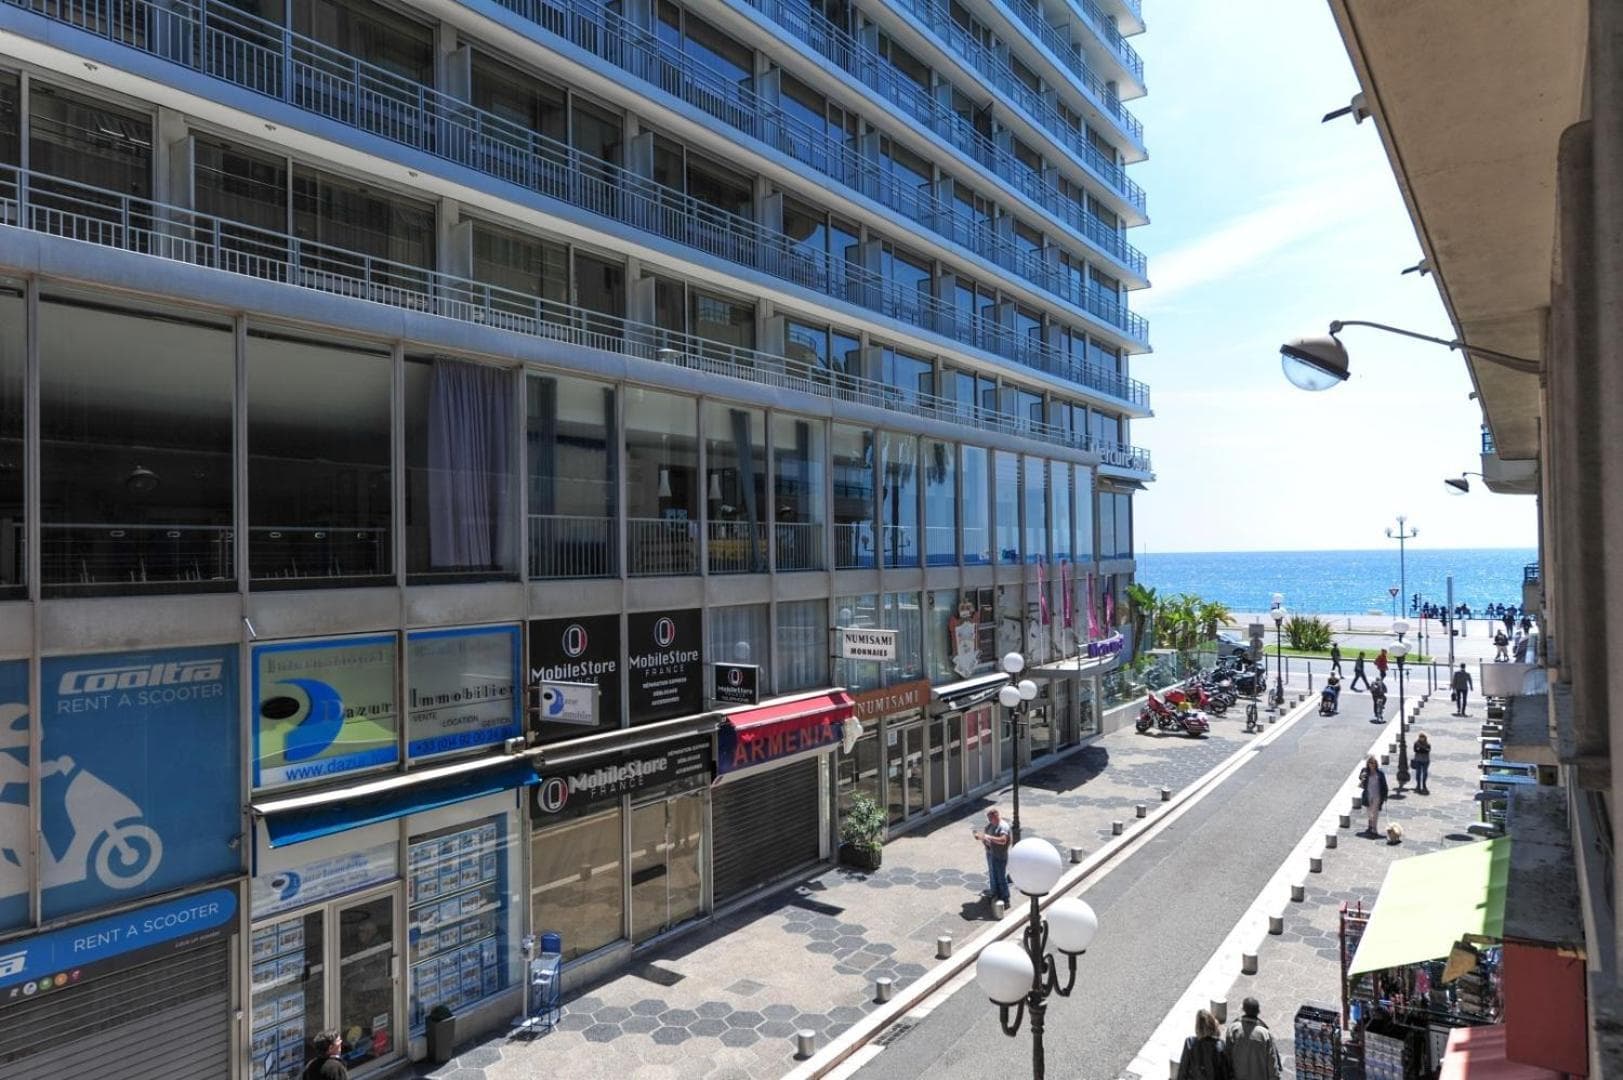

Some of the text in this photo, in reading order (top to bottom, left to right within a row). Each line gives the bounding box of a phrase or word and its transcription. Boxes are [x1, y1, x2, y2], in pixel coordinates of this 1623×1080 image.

[845, 634, 893, 646] NUMISAMI
[531, 661, 616, 682] MobileStore
[629, 650, 699, 670] MobileStore
[645, 664, 685, 677] FRANCE
[58, 658, 224, 696] Cooltra
[57, 683, 224, 714] RENT A SCOOTER
[857, 689, 919, 717] NUMISAMI
[732, 720, 835, 768] ARMENIA
[567, 757, 668, 794] MobileStore
[591, 778, 645, 798] FRANCE
[74, 902, 220, 953] RENT A SCOOTER
